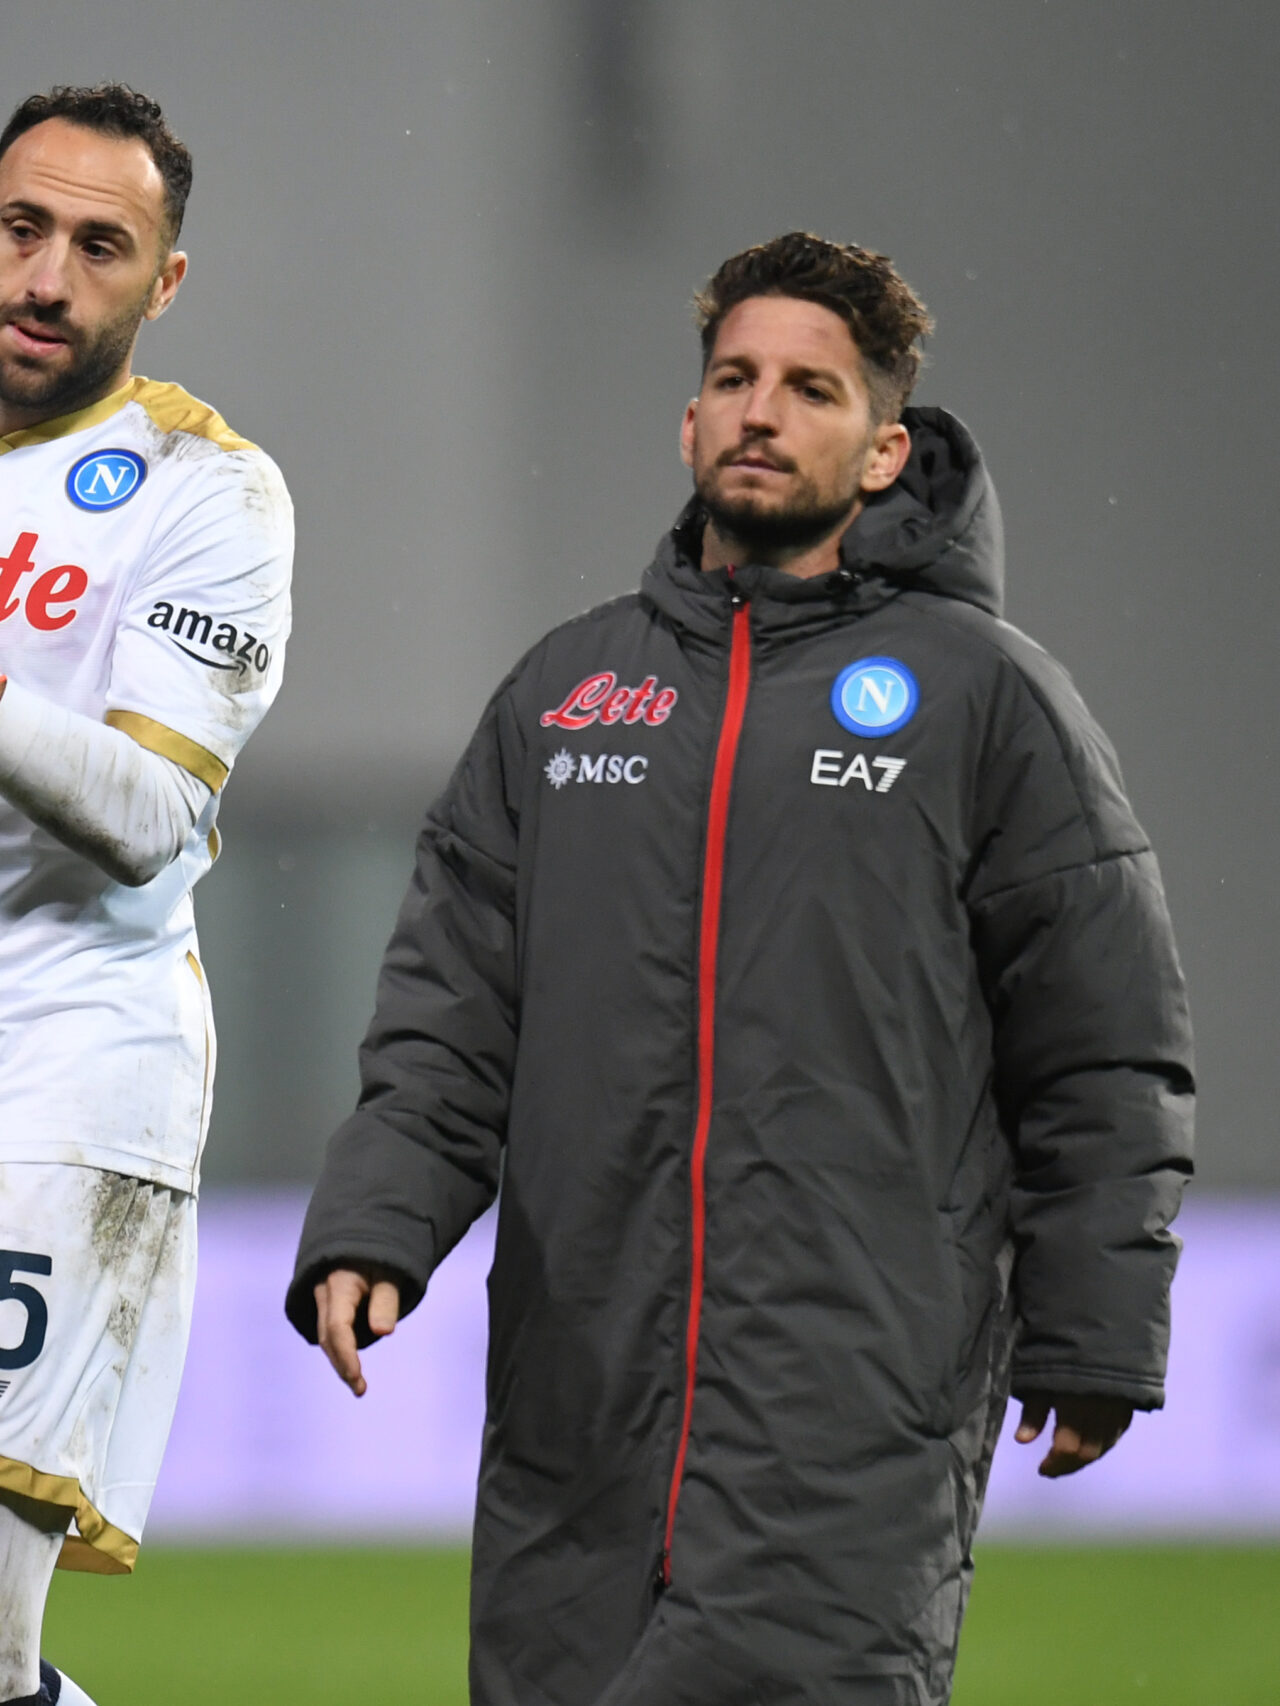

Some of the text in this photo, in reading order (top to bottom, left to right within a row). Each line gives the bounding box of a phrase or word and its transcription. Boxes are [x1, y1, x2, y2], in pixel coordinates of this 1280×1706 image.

[85, 463, 128, 496] N
[147, 601, 272, 674] amazo
[540, 670, 678, 730] Lete
[857, 677, 895, 714] N
[575, 753, 649, 785] MSC
[810, 749, 907, 793] EA7
